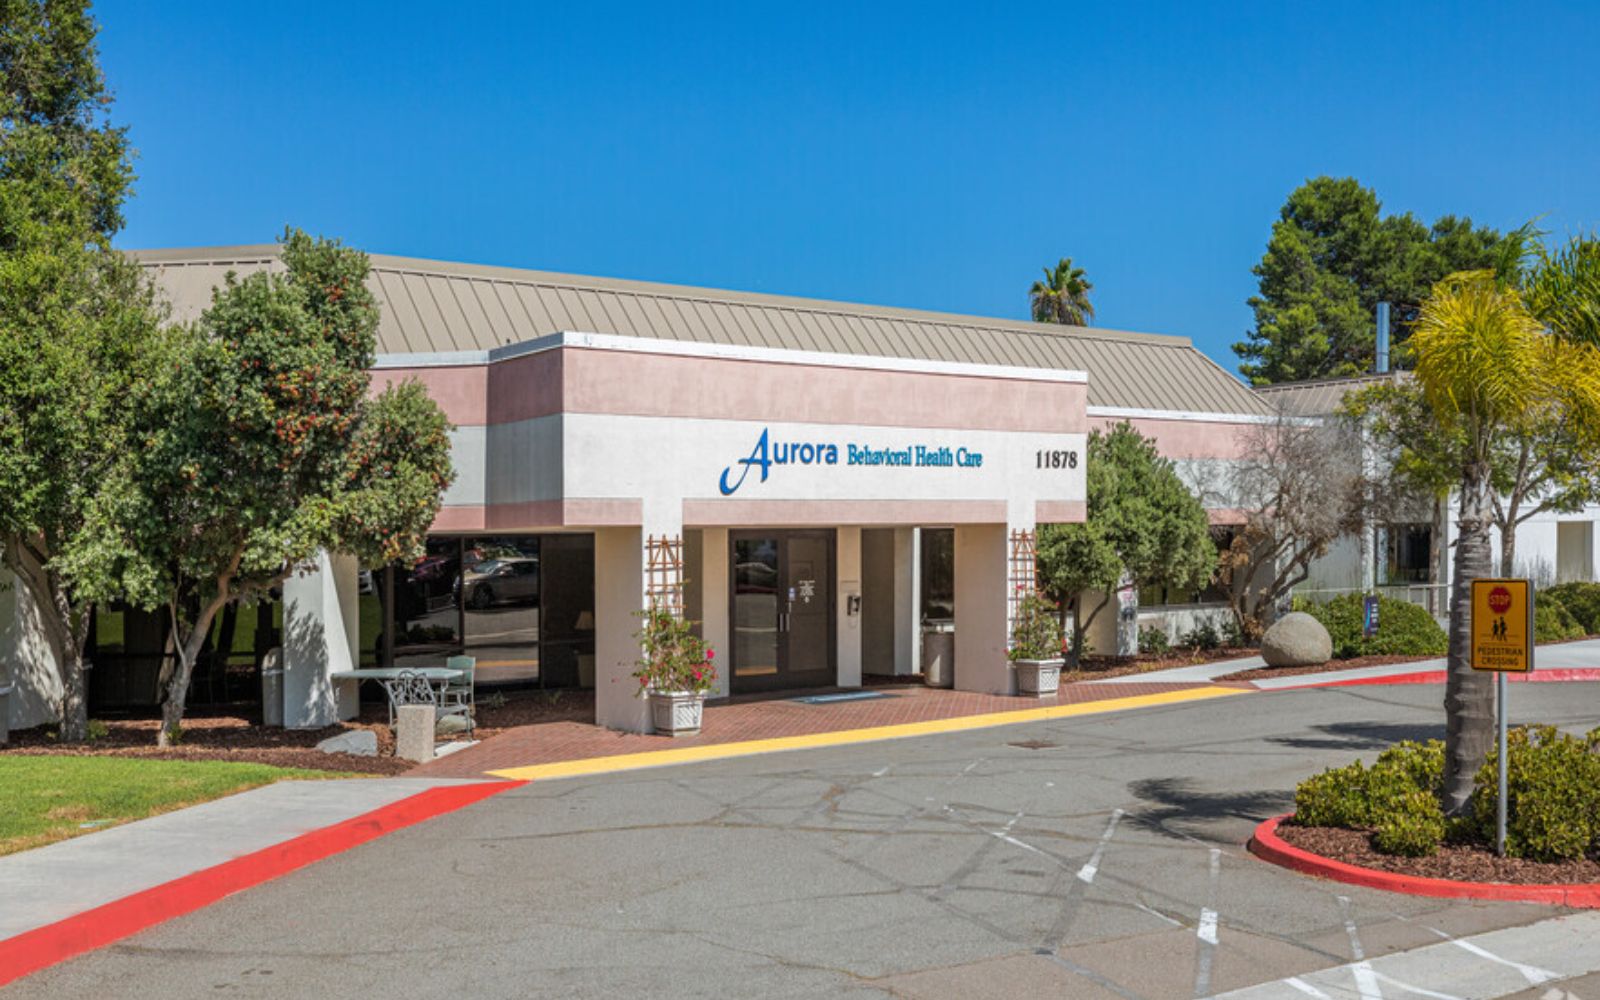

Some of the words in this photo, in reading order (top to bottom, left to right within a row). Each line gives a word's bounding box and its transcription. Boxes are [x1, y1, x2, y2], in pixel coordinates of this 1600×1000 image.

[719, 426, 838, 496] Aurora
[847, 443, 911, 466] Behavioral
[915, 446, 953, 467] Health
[956, 447, 983, 468] Care
[1036, 450, 1078, 469] 11878
[1490, 595, 1510, 606] STOP
[1477, 646, 1523, 657] PEDESTRIAN
[1481, 656, 1519, 667] CROSSING
